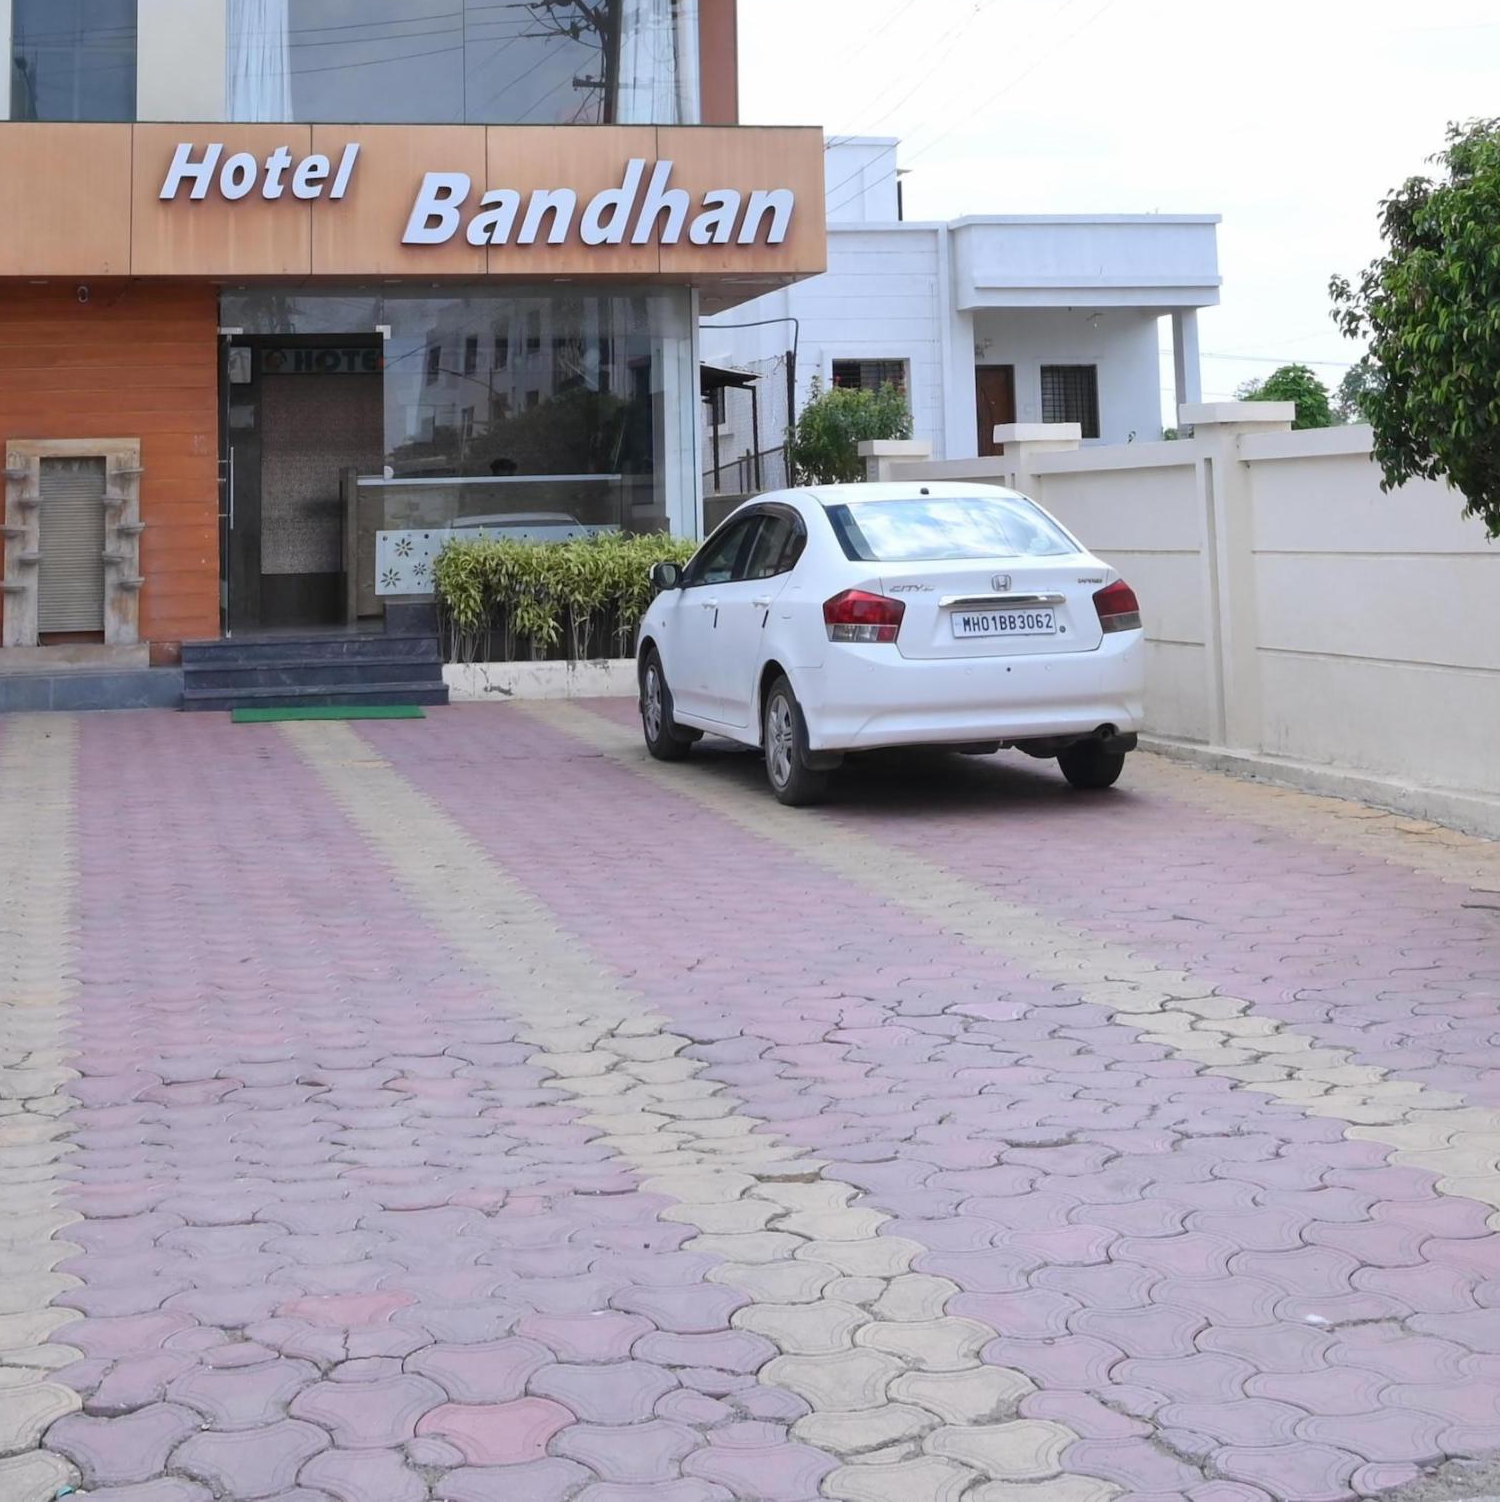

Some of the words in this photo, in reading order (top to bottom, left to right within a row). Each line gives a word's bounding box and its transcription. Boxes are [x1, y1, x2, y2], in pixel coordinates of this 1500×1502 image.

[159, 143, 360, 201] Hotel
[401, 158, 795, 246] Bandhan
[963, 613, 1053, 632] MH01BB3062
